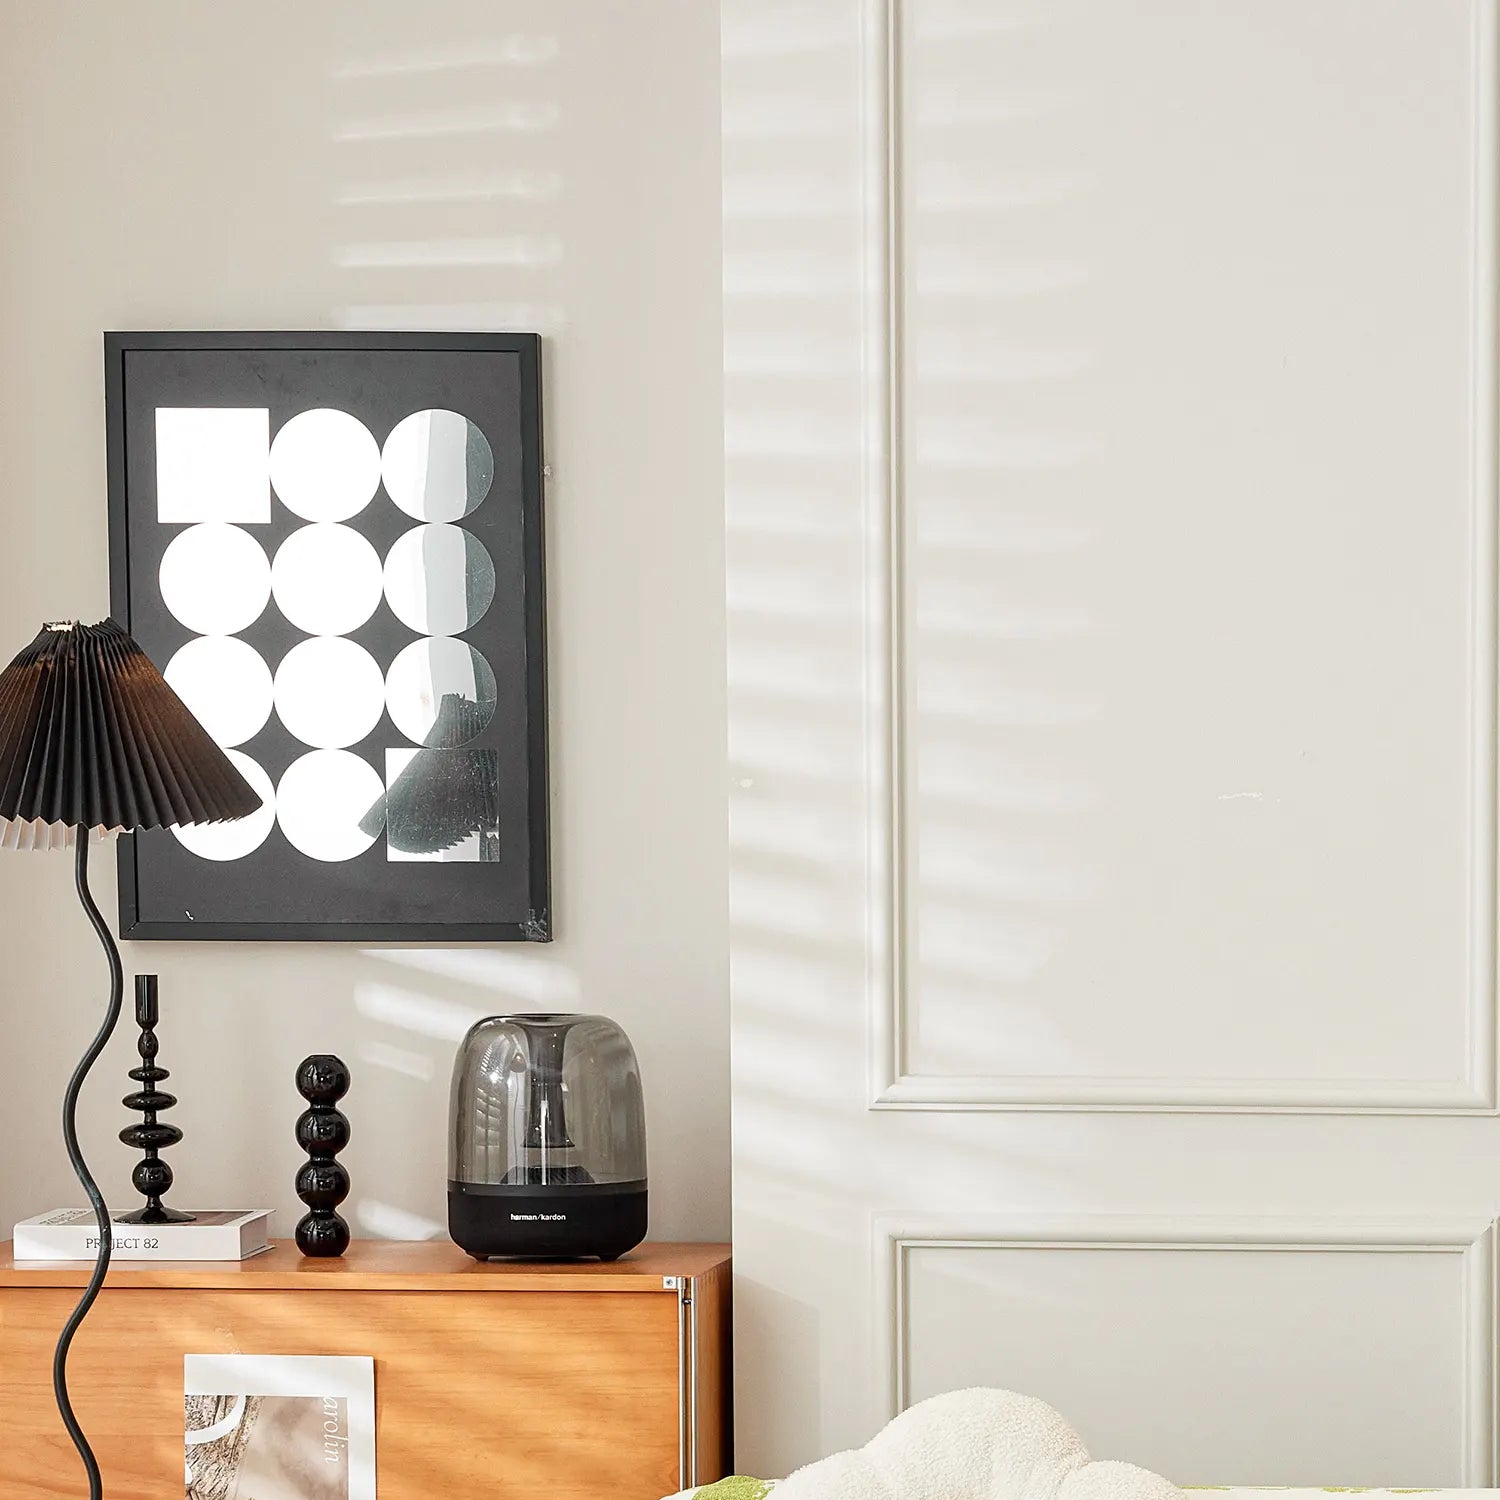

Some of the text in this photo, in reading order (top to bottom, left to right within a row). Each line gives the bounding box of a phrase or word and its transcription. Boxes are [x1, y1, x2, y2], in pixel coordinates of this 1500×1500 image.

[510, 1213, 567, 1221] harman/kardon
[86, 1238, 159, 1250] PRJECT 82
